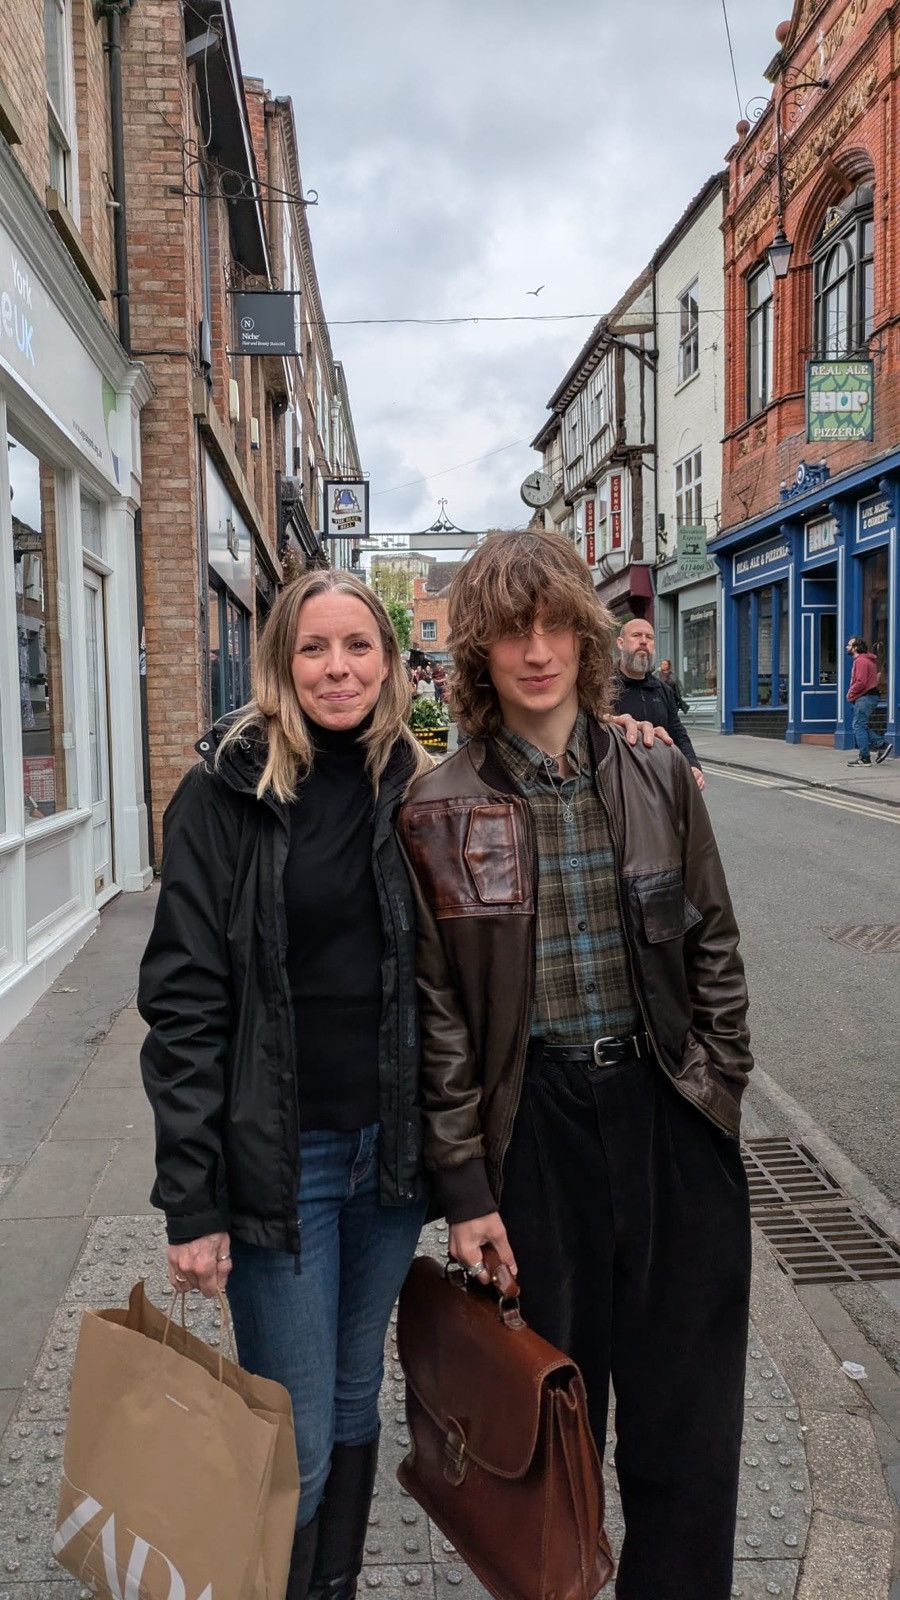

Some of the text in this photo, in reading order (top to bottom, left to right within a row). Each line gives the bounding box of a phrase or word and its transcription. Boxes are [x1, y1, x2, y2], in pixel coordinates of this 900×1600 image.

[11, 254, 32, 310] York
[244, 320, 251, 328] N
[241, 332, 260, 340] Niche
[811, 365, 869, 376] REAL ALE
[819, 391, 869, 413] HOP
[814, 427, 866, 438] PIZZERIA
[736, 560, 750, 575] REAL
[749, 555, 760, 569] ALE
